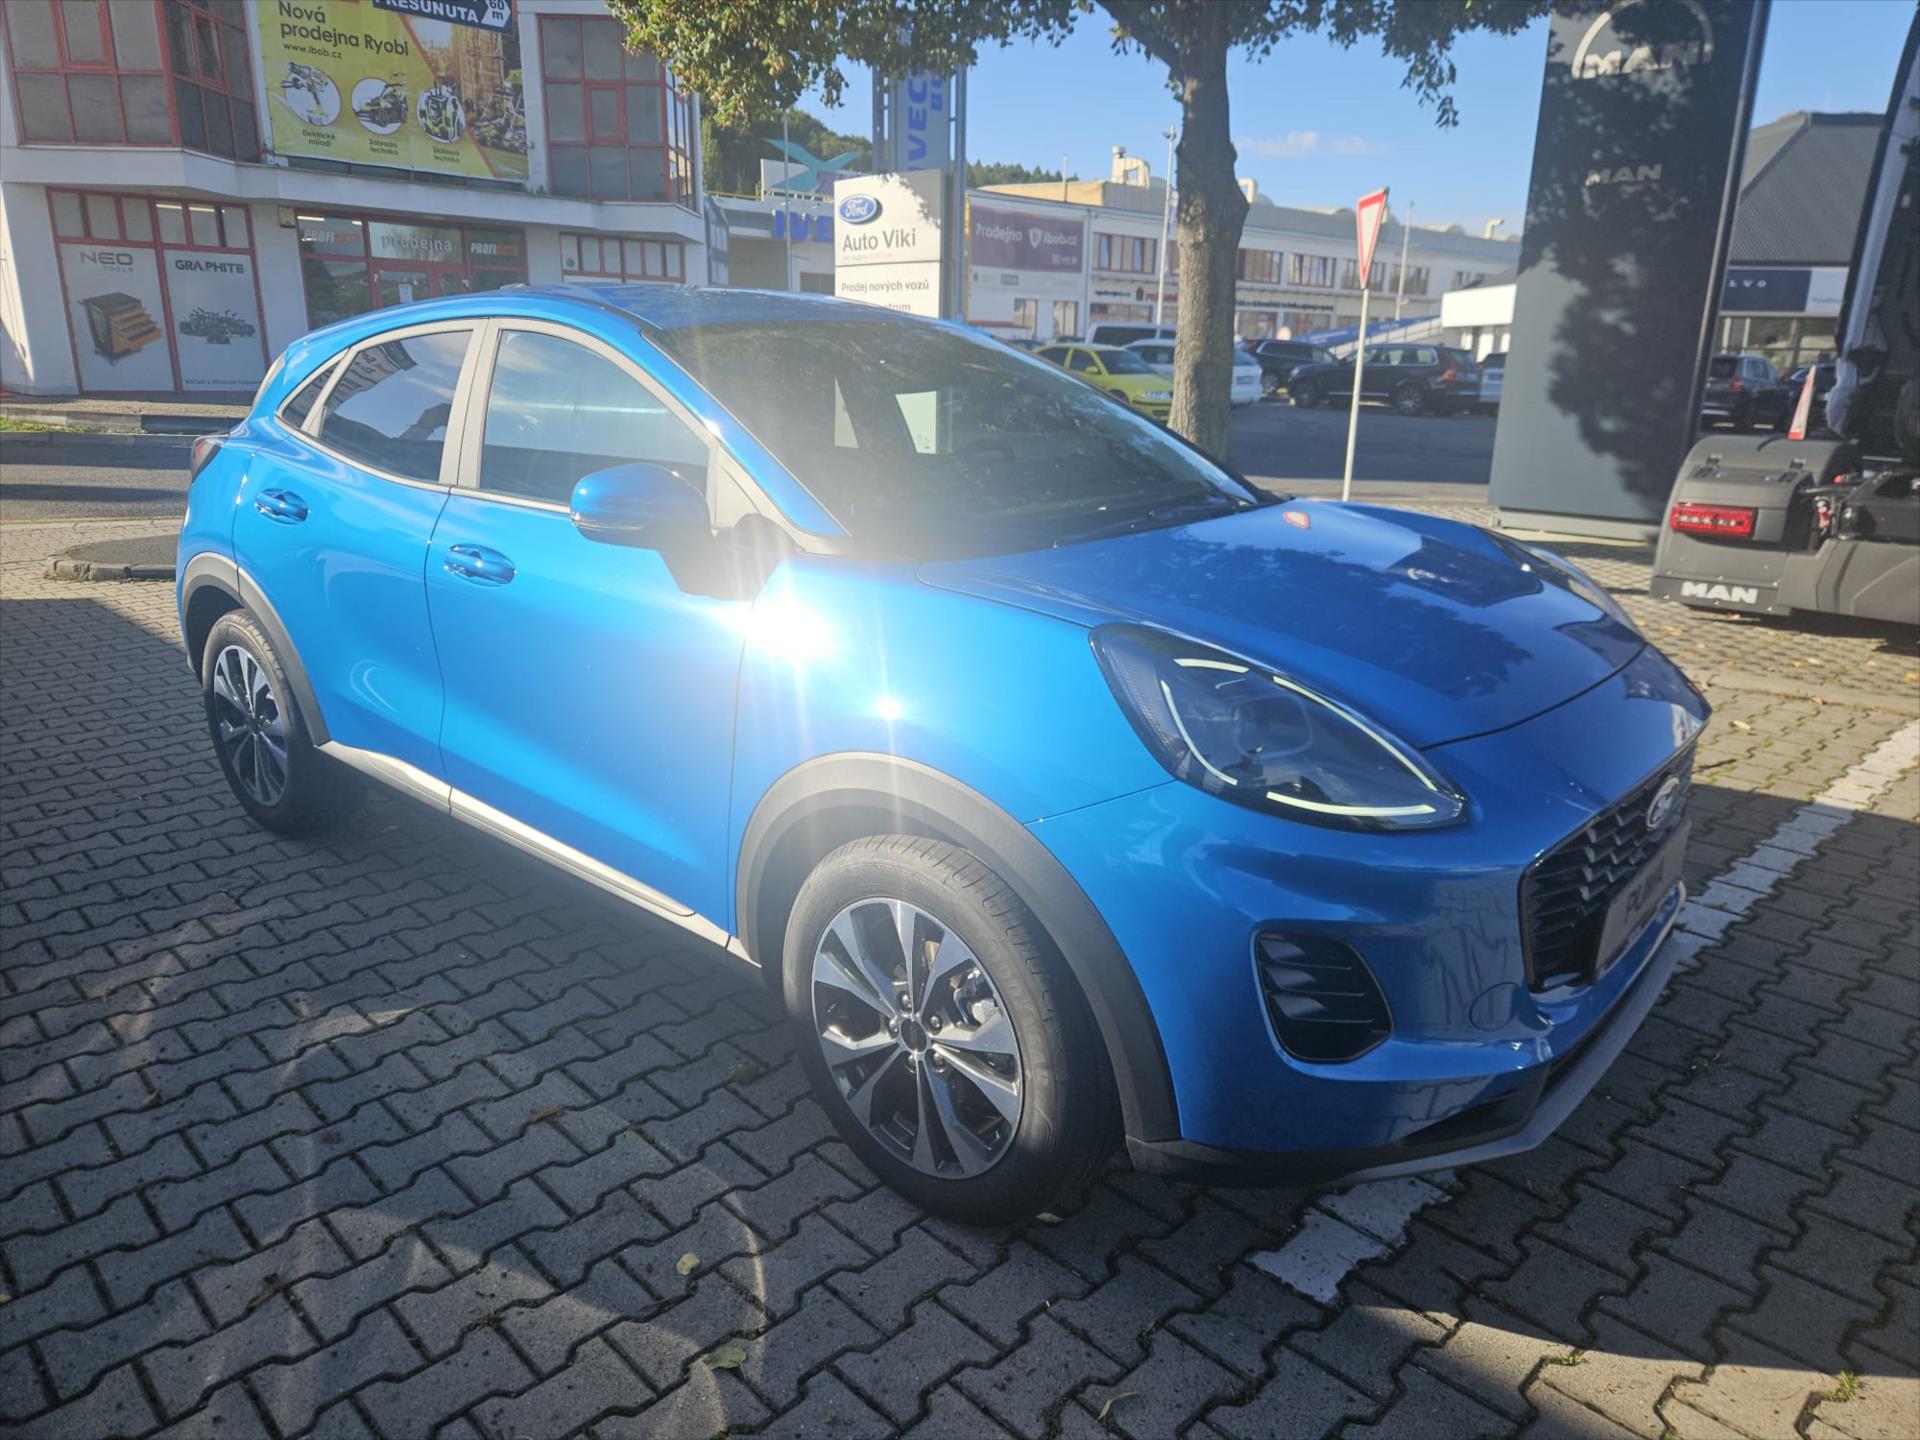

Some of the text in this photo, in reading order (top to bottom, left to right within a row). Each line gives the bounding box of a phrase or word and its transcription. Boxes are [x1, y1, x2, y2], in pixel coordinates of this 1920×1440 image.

[279, 0, 326, 23] Nová
[376, 0, 478, 23] ESUNUTA
[492, 11, 504, 20] m
[280, 22, 409, 56] prodejna Ryobi
[283, 43, 343, 59] www.ibob.cz
[1583, 40, 1700, 79] MAN
[1586, 164, 1662, 186] MAN
[382, 233, 452, 253] prodejna
[842, 227, 917, 252] Auto Viki
[976, 223, 1022, 244] Prodejna
[80, 252, 134, 265] NEO
[104, 265, 134, 273] TOOLS
[175, 259, 244, 274] GRAPHITE
[841, 279, 929, 293] Prodej nových vozů
[1681, 581, 1758, 604] MAN
